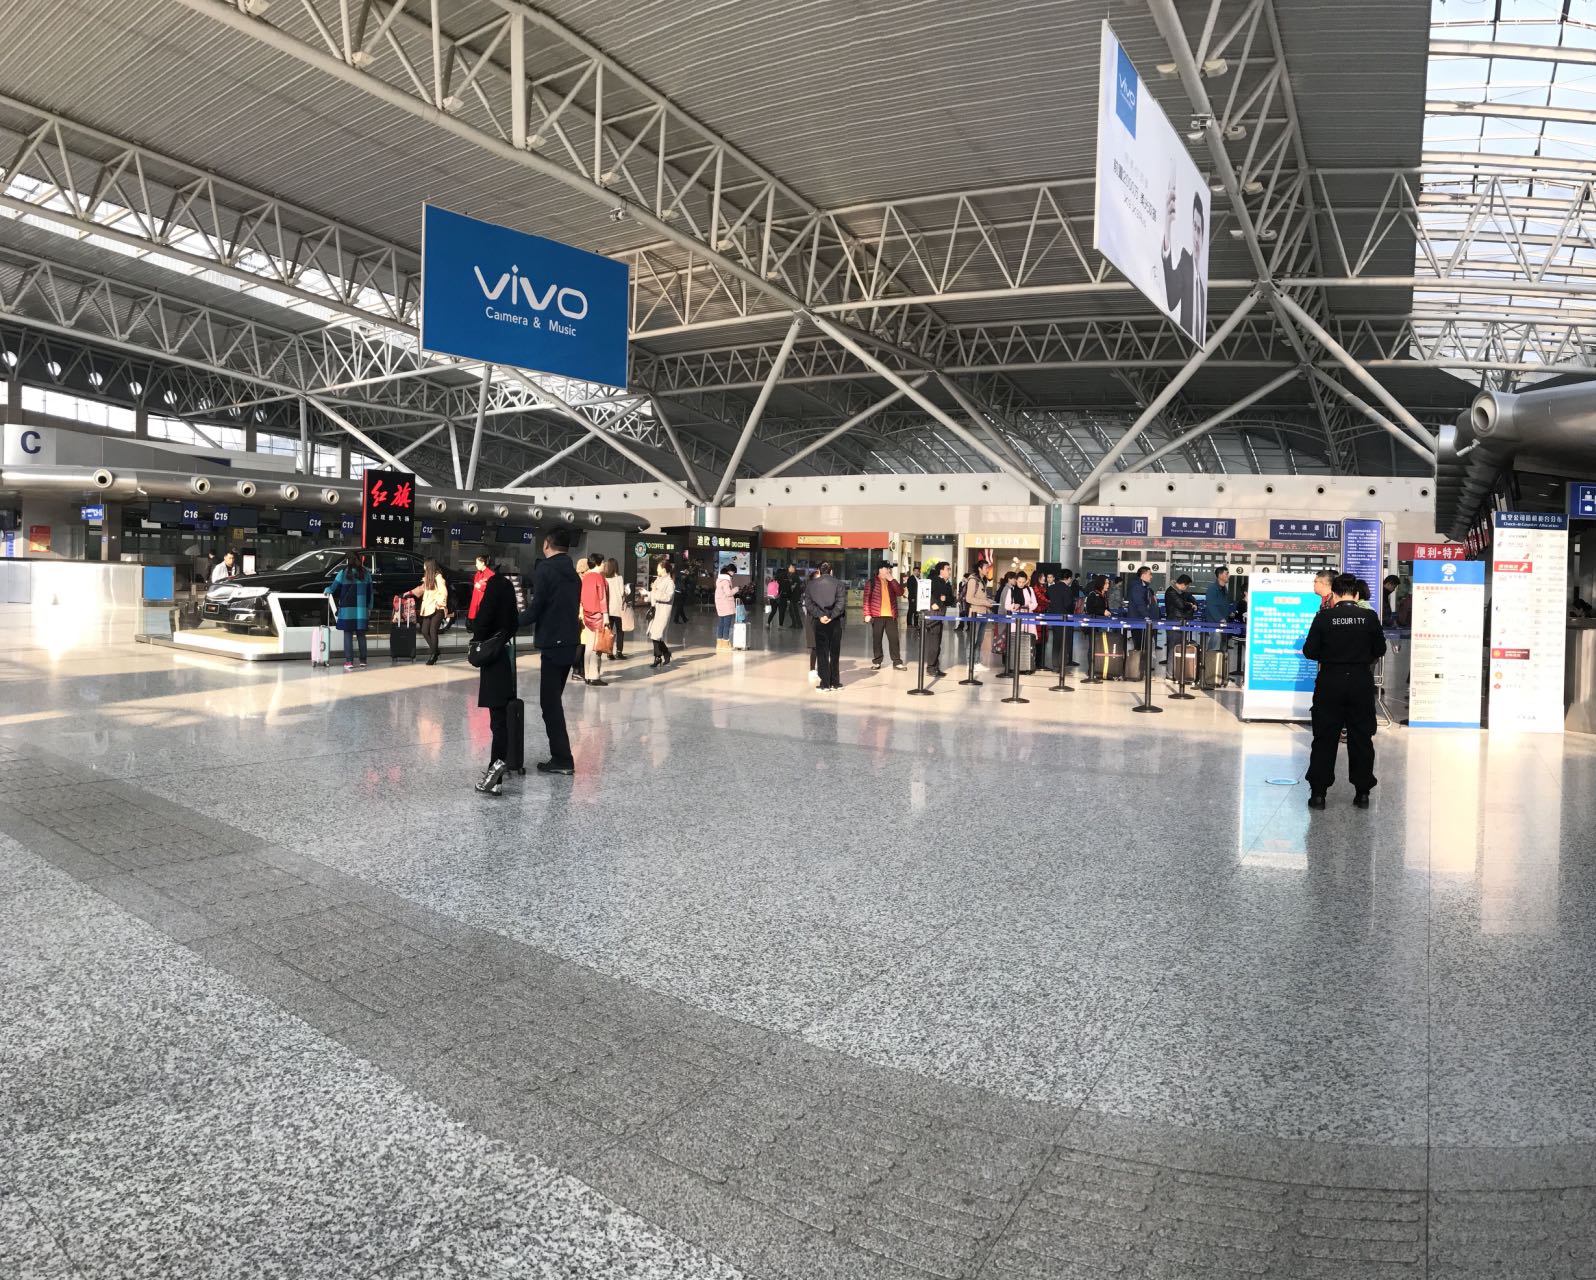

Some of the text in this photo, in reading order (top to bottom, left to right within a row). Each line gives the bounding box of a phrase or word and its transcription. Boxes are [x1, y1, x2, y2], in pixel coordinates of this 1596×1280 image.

[474, 265, 588, 320] vivo
[485, 306, 577, 337] Camera & Music
[20, 430, 41, 454] C
[370, 479, 412, 508] 红旗
[183, 510, 198, 519] C16
[214, 511, 228, 521] C15
[309, 518, 322, 527] C14
[342, 521, 354, 529] C13
[422, 526, 433, 534] C12
[1332, 617, 1366, 625] SECURITY
